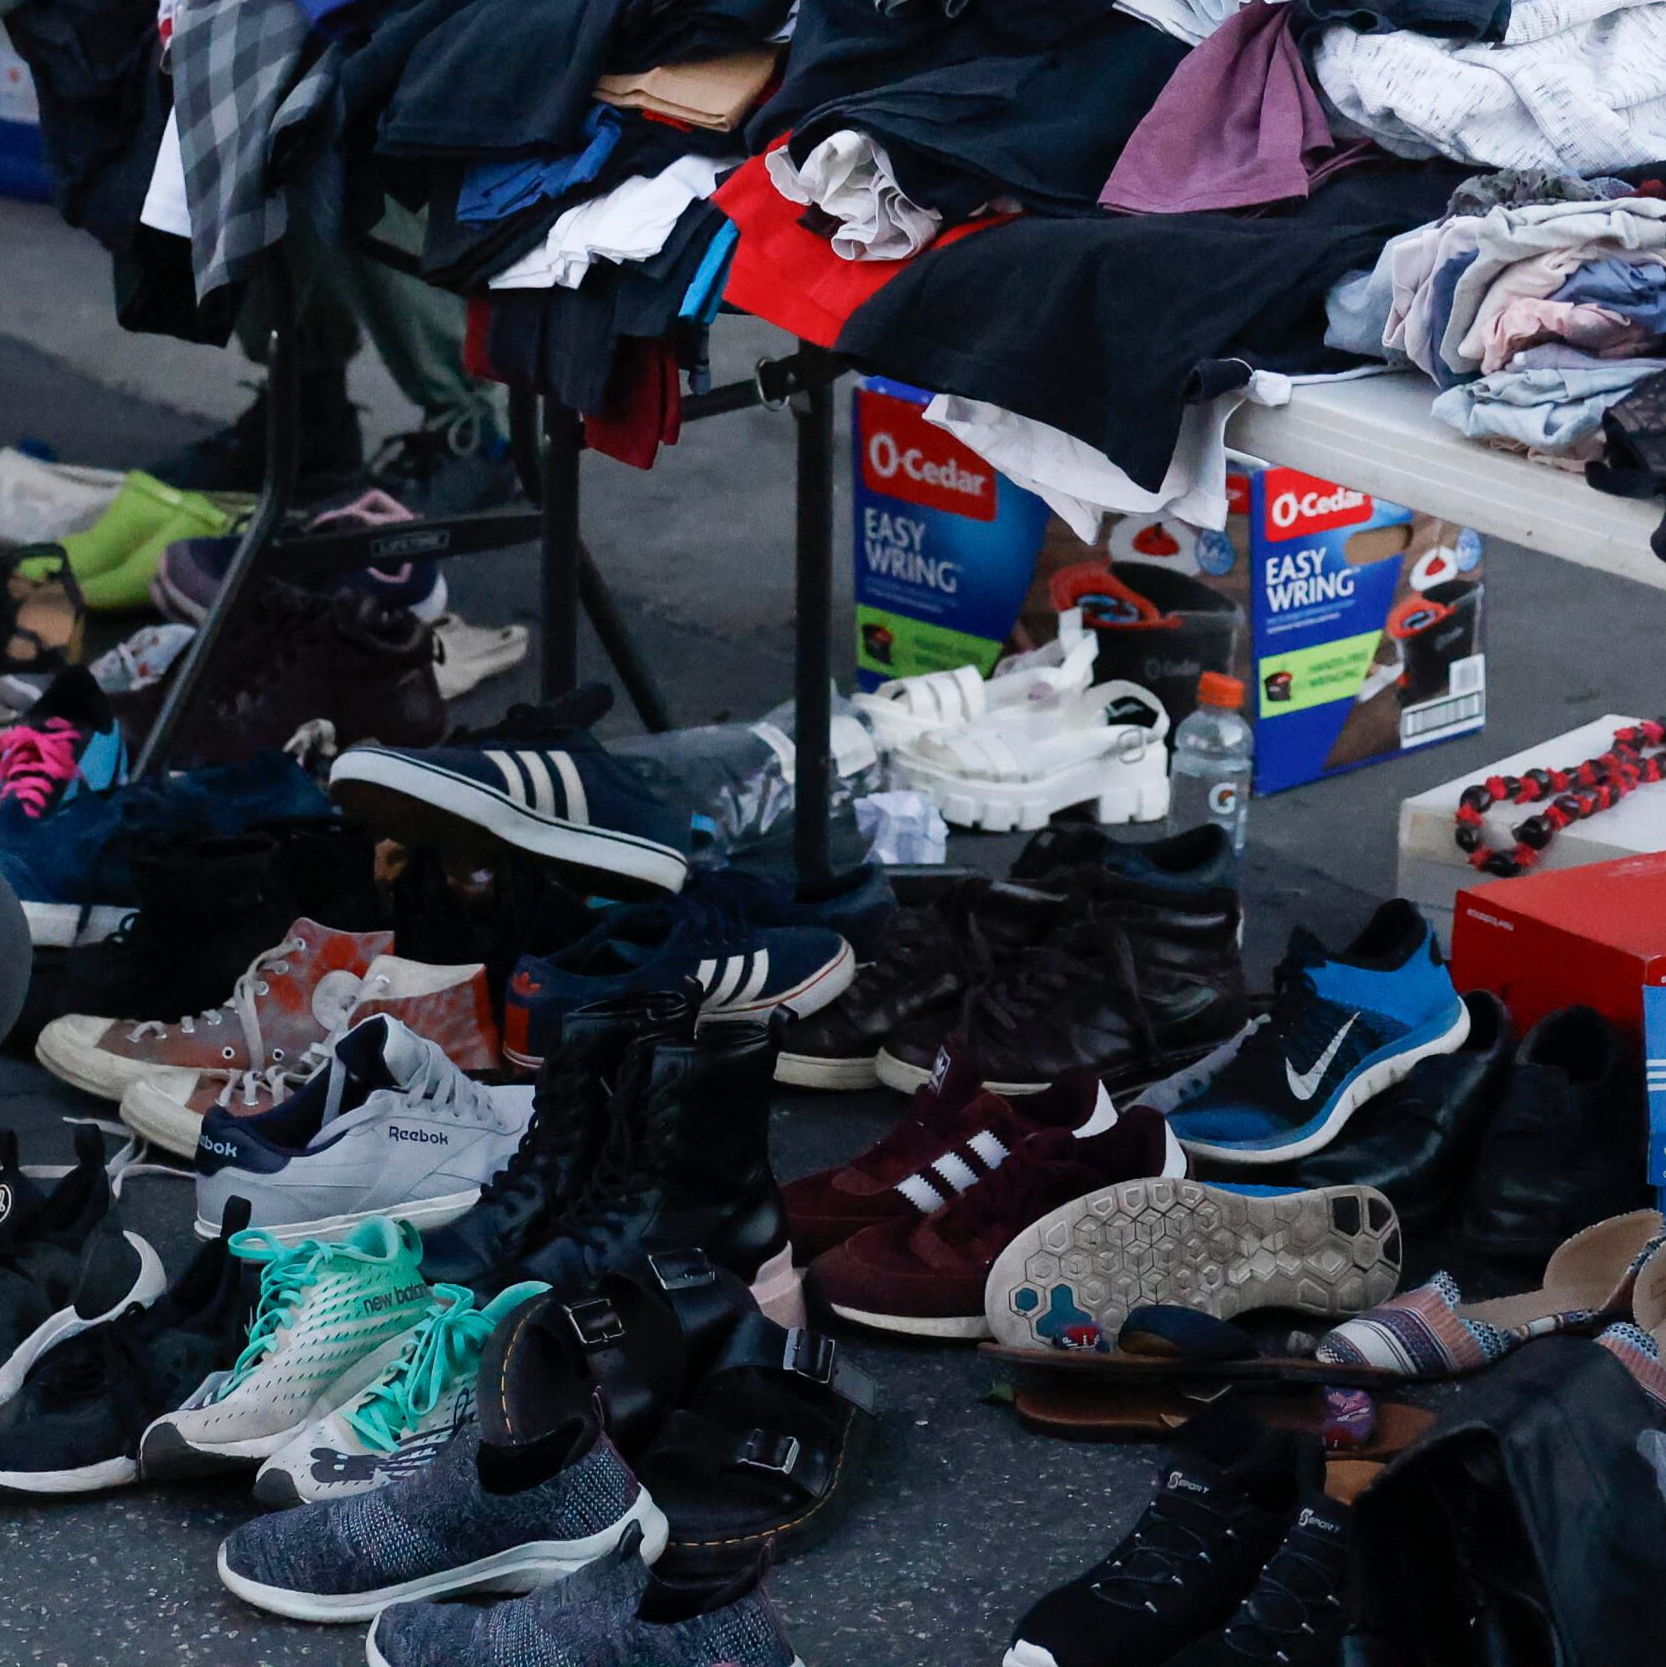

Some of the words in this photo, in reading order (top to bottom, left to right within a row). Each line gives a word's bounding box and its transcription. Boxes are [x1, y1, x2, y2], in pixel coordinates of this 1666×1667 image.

[869, 432, 986, 497] O-Cedar
[864, 507, 925, 551] EASY
[865, 540, 958, 594] WRING
[1265, 547, 1326, 587] EASY
[1266, 569, 1355, 614] WRING
[1208, 782, 1238, 815] G
[389, 1125, 449, 1147] Reebok
[363, 1290, 394, 1315] new
